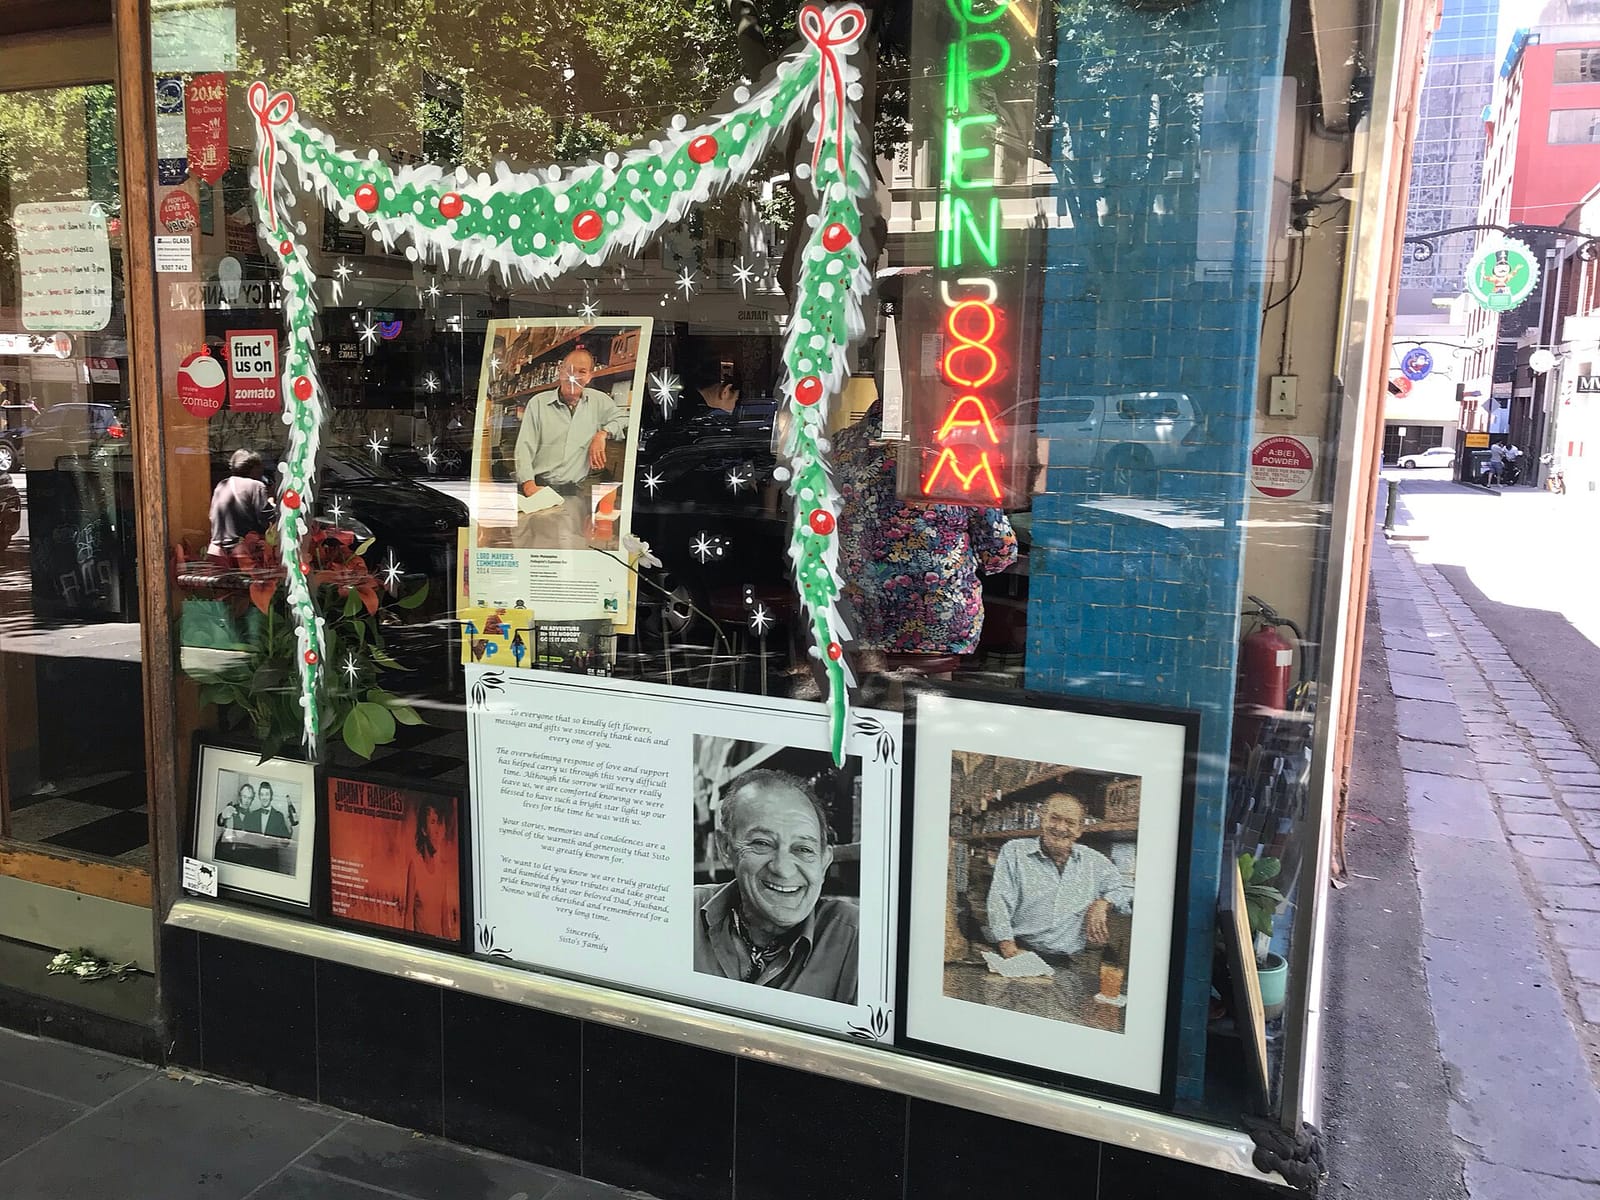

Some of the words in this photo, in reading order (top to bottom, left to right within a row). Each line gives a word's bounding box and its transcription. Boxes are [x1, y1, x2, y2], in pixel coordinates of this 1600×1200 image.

[191, 107, 202, 115] Top
[203, 105, 223, 113] Choice
[164, 203, 181, 213] LOVE
[181, 202, 190, 210] US
[234, 342, 261, 357] find
[236, 361, 251, 372] us
[254, 361, 272, 372] on
[182, 396, 219, 409] zomato
[235, 387, 275, 399] zomato
[1262, 457, 1300, 466] POWDER
[477, 560, 519, 568] COMMENDATIONS
[495, 718, 528, 729] messages
[528, 719, 543, 730] and
[543, 721, 561, 735] gifts
[561, 726, 573, 734] we
[574, 726, 609, 741] sincerely
[609, 730, 633, 742] thank
[633, 733, 652, 744] each
[653, 737, 669, 747] and
[510, 708, 520, 716] To
[520, 711, 554, 722] everyone
[555, 713, 571, 723] that
[582, 716, 607, 731] kindly
[607, 720, 621, 733] left
[622, 722, 653, 737] flowers,
[548, 735, 571, 746] every
[571, 738, 585, 746] one
[586, 737, 594, 749] of
[595, 741, 612, 750] you.
[495, 746, 509, 755] The
[510, 750, 562, 765] overwhelming
[563, 757, 595, 770] response
[596, 759, 604, 772] of
[605, 761, 622, 772] love
[622, 765, 638, 774] and
[639, 768, 671, 781] support
[498, 755, 511, 765] has
[512, 758, 536, 771] helped
[536, 763, 558, 775] carry
[569, 765, 600, 780] through
[600, 770, 615, 781] this
[616, 775, 635, 786] very
[635, 775, 667, 791] difficult
[501, 776, 521, 787] leave
[522, 781, 532, 789] us,
[545, 785, 559, 793] are
[559, 784, 597, 801] comforted
[598, 790, 631, 806] knowing
[632, 798, 644, 806] we
[645, 800, 665, 809] were
[503, 767, 523, 777] time.
[523, 768, 557, 785] Although
[558, 774, 571, 784] the
[571, 779, 598, 789] sorrow
[599, 780, 615, 791] will
[614, 785, 638, 794] never
[639, 787, 663, 801] really
[367, 786, 403, 812] BARNES
[500, 785, 525, 797] blessed
[526, 790, 534, 799] to
[534, 791, 553, 802] have
[554, 794, 572, 805] such
[579, 797, 602, 811] bright
[604, 804, 620, 812] star
[621, 805, 639, 818] light
[639, 810, 651, 820] up
[498, 827, 524, 838] symbol
[524, 828, 532, 840] of
[533, 830, 545, 840] the
[546, 832, 577, 846] warmth
[577, 838, 592, 849] and
[593, 841, 633, 858] generosity
[633, 847, 651, 858] that
[650, 850, 671, 862] Sisto
[502, 817, 520, 826] Your
[520, 819, 547, 831] stories,
[547, 825, 583, 837] memories
[583, 831, 599, 839] and
[600, 832, 644, 847] condolences
[645, 842, 659, 850] are
[540, 844, 555, 852] was
[556, 844, 584, 859] greatly
[584, 848, 610, 862] known
[611, 854, 625, 865] for.
[501, 854, 512, 864] We
[513, 859, 532, 868] want
[542, 862, 552, 871] let
[553, 866, 568, 876] you
[568, 866, 589, 878] know
[602, 875, 616, 883] are
[616, 875, 637, 889] truly
[637, 880, 669, 894] grateful
[503, 867, 517, 875] and
[518, 867, 550, 881] humbled
[550, 873, 560, 886] by
[561, 877, 580, 889] your
[580, 879, 609, 892] tributes
[610, 885, 626, 895] and
[627, 887, 644, 898] take
[644, 891, 666, 903] great
[500, 874, 519, 885] pride
[520, 877, 551, 893] knowing
[552, 883, 568, 894] that
[569, 889, 583, 897] our
[583, 889, 612, 902] beloved
[612, 894, 632, 907] Dad,
[632, 898, 670, 914] Husband,
[559, 935, 581, 946] Sisto's
[581, 938, 609, 954] Family
[565, 926, 601, 942] Sincerely,
